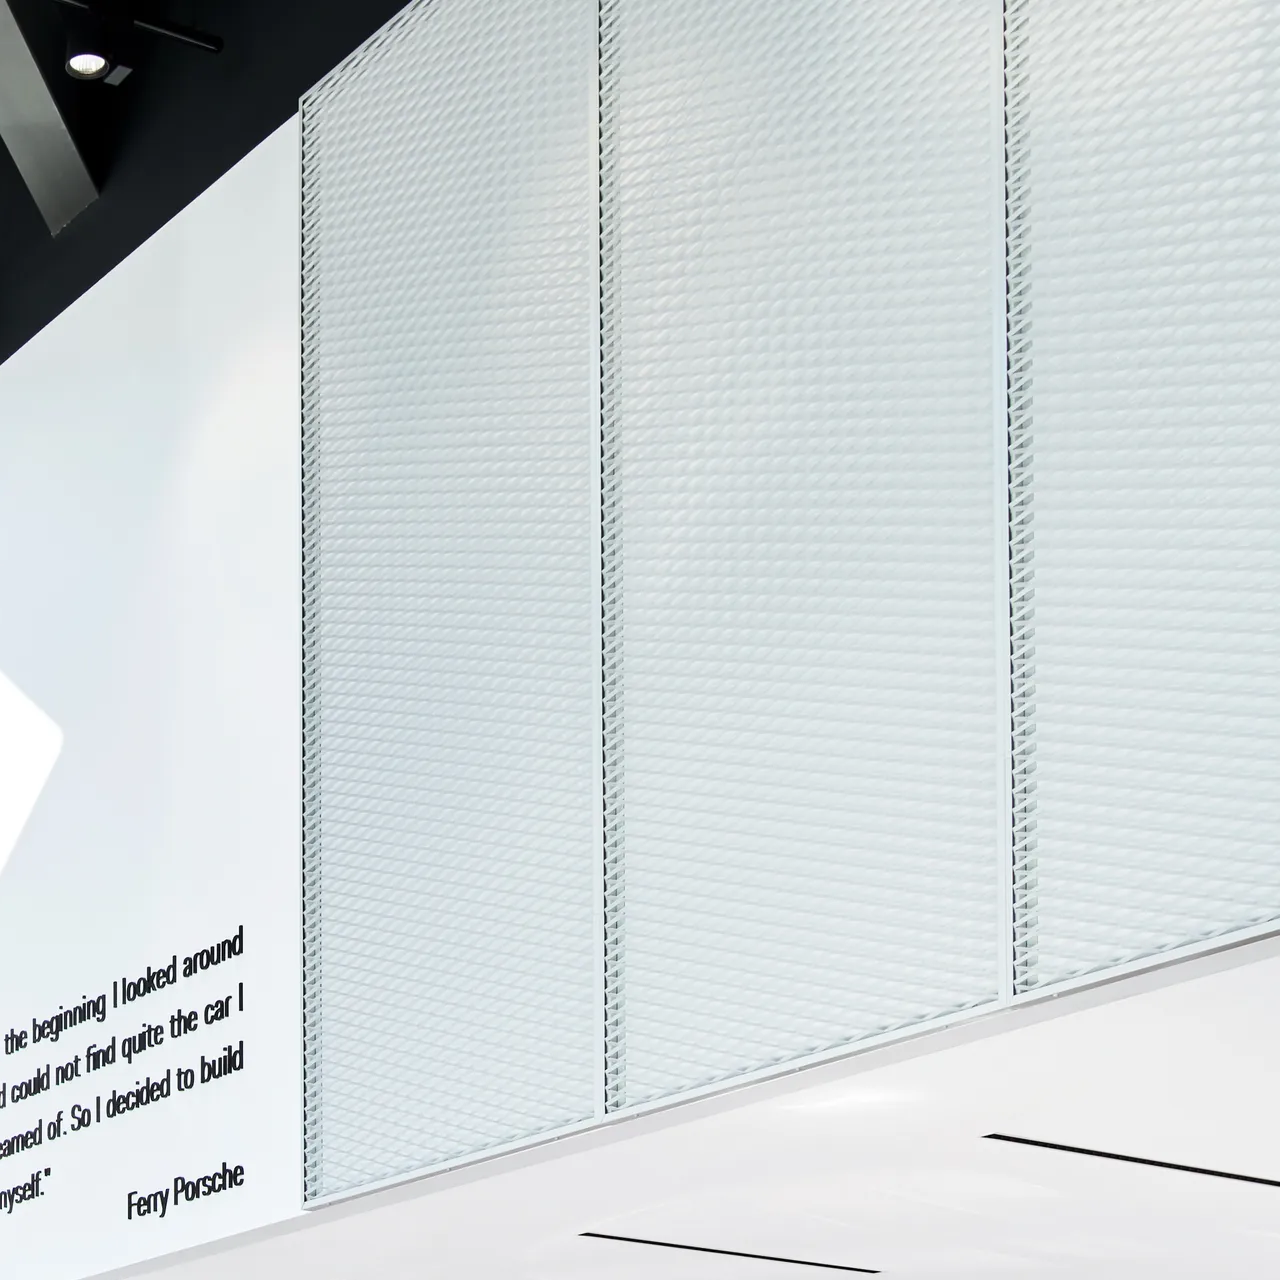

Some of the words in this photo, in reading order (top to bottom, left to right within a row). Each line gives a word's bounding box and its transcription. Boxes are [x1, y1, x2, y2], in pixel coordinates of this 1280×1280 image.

[4, 1028, 28, 1055] the
[32, 994, 107, 1043] beginning
[113, 981, 118, 1008] I
[122, 955, 177, 1005] looked
[183, 925, 244, 978] around
[10, 1064, 51, 1103] could
[55, 1055, 82, 1085] not
[85, 1036, 116, 1073] find
[121, 1023, 164, 1064] quite
[169, 1009, 199, 1038] the
[204, 996, 233, 1025] car
[238, 983, 244, 1011] I
[47, 1110, 68, 1140] of.
[71, 1104, 91, 1131] So
[96, 1096, 101, 1122] I
[106, 1069, 171, 1118] decided
[175, 1068, 195, 1091] to
[201, 1041, 244, 1083] build
[127, 1189, 170, 1220] Ferry
[173, 1162, 245, 1205] Porsche
